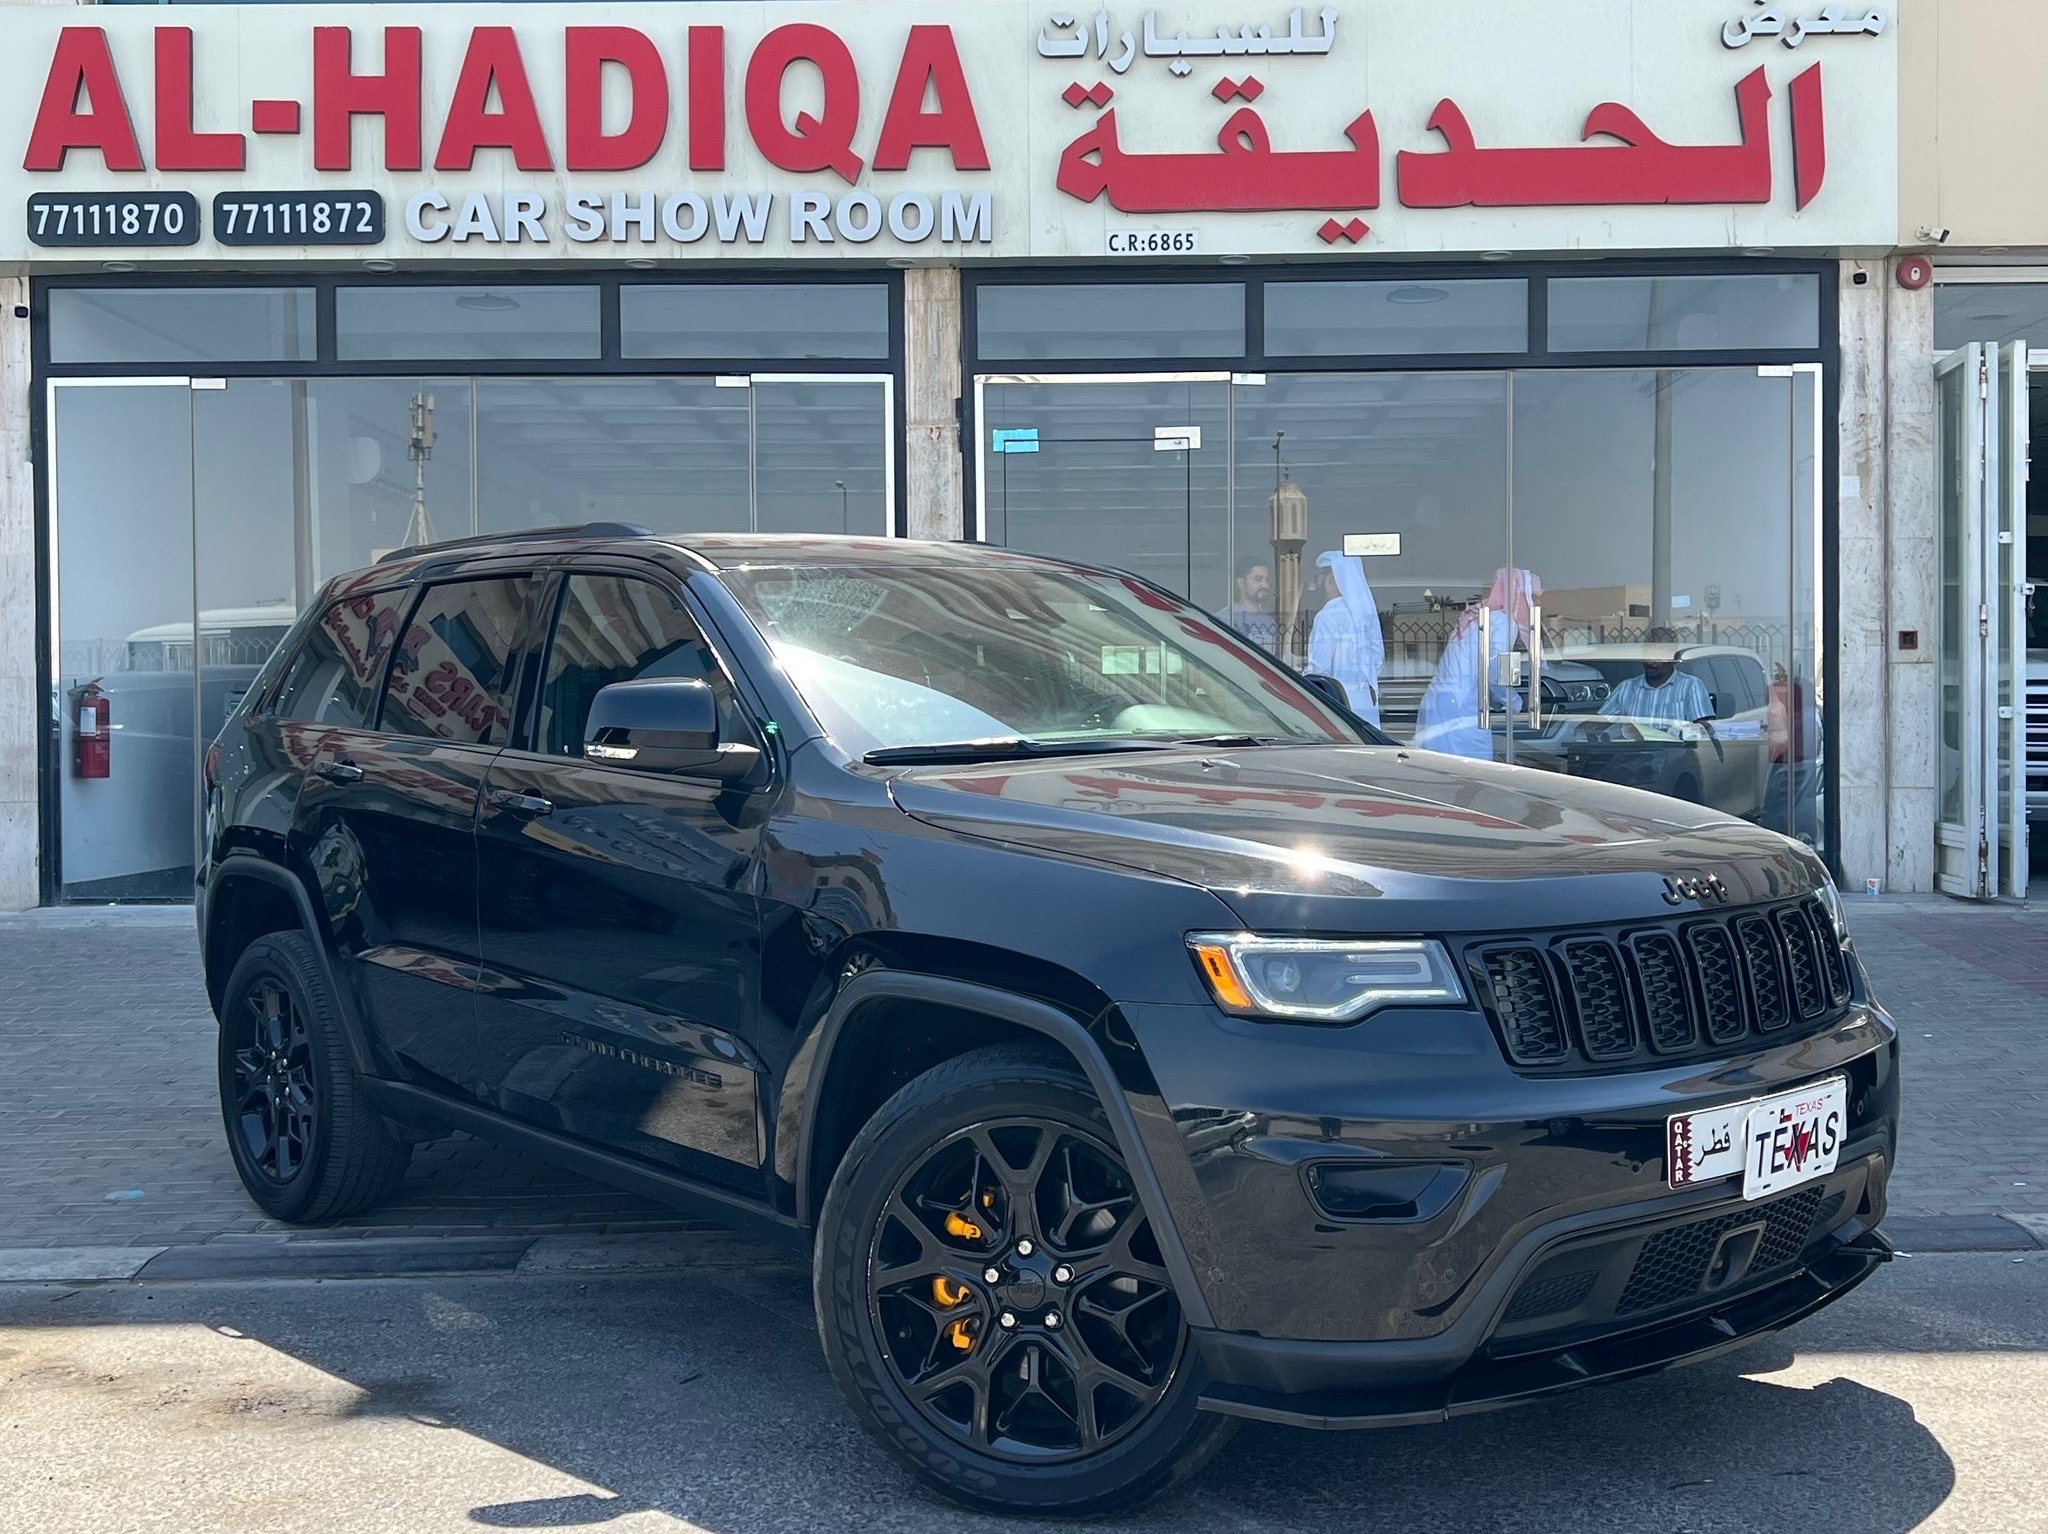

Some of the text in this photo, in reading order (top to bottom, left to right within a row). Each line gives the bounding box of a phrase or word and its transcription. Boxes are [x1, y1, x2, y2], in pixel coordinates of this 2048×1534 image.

[1037, 6, 1338, 76] للسيارات
[1721, 0, 1886, 49] معرض
[23, 22, 991, 186] AL-HADIQA
[1056, 61, 1825, 244] الحديقة
[33, 202, 185, 236] 77111870
[222, 200, 374, 235] 77111872
[404, 190, 993, 244] CAR SHOW ROOM
[1108, 232, 1195, 252] C.R:6865
[1795, 1097, 1823, 1116] TEXAS
[1674, 1121, 1684, 1182] QATAR
[1694, 1122, 1731, 1166] قطر
[1755, 1111, 1839, 1178] TEXAS
